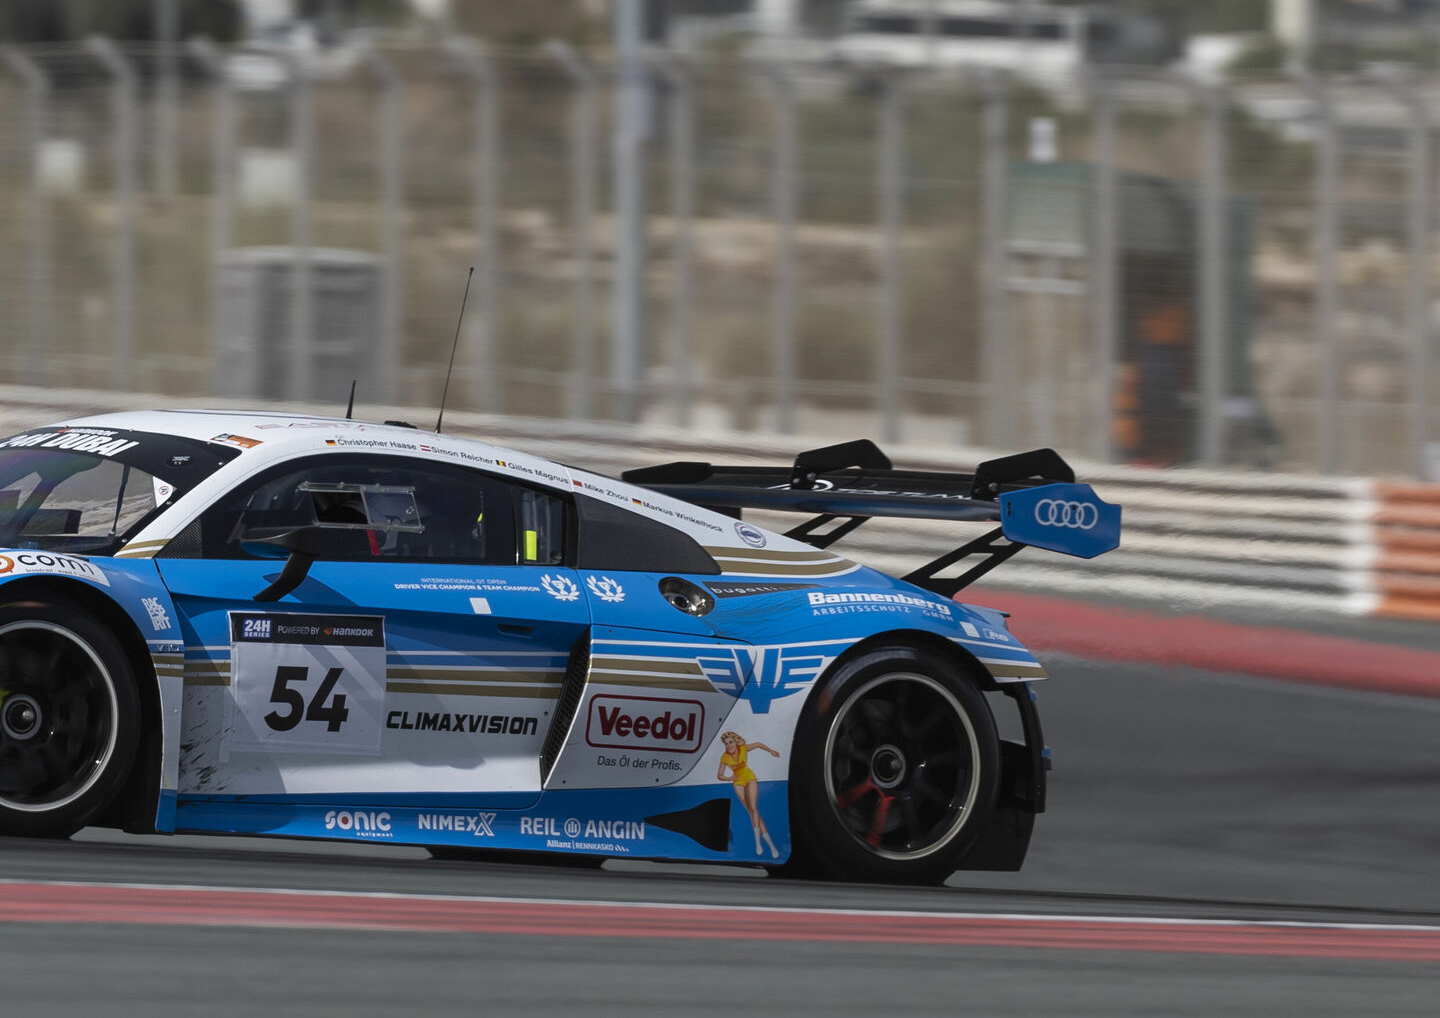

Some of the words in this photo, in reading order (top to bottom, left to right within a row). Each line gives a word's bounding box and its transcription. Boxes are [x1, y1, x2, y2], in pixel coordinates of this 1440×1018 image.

[40, 432, 140, 457] DUBAI
[337, 439, 388, 448] Christopher
[389, 441, 417, 450] Haase
[430, 446, 459, 457] Simon
[460, 452, 494, 464] Reicher
[508, 462, 533, 475] Gilles
[534, 469, 569, 484] Magnus
[606, 488, 629, 502] Zhou
[642, 501, 674, 517] Markus
[807, 592, 951, 615] Bannenberg
[813, 605, 911, 617] ARBEITSSCHUTZ
[244, 620, 271, 632] 24H
[277, 625, 310, 635] POWERED
[310, 626, 320, 635] BY
[264, 666, 349, 732] 54
[598, 705, 696, 741] Veedol
[597, 755, 617, 767] Das
[618, 754, 630, 767] Öl
[632, 758, 650, 769] der
[651, 758, 683, 771] Profis.
[520, 816, 561, 836] REIL
[584, 820, 645, 840] ANGIN
[547, 840, 572, 849] Allianz
